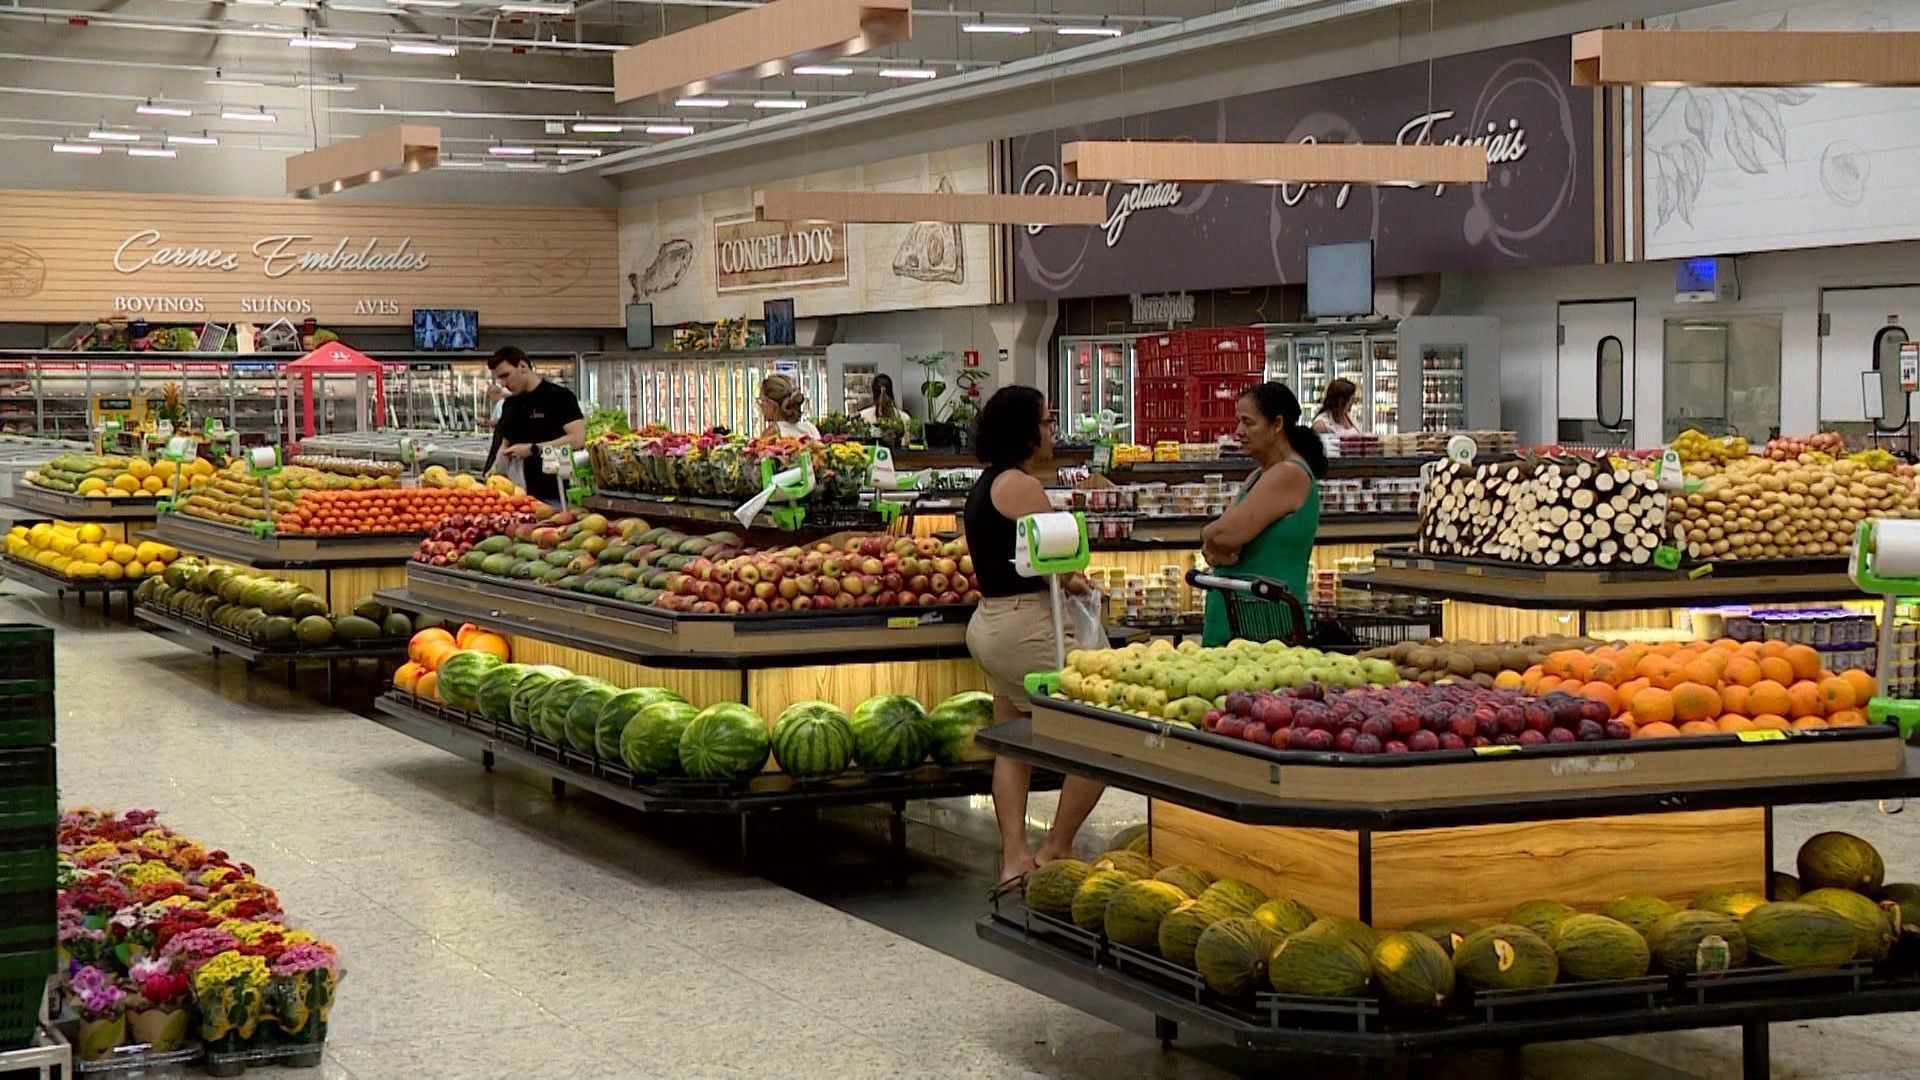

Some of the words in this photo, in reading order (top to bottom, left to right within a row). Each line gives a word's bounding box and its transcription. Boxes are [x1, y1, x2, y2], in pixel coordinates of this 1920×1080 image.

[113, 229, 239, 273] Carnes
[252, 235, 429, 277] Embaladas
[721, 226, 833, 273] CONGELADOS
[114, 296, 205, 313] BOVINOS
[241, 295, 311, 314] SUÍNOS
[354, 299, 399, 314] AVES
